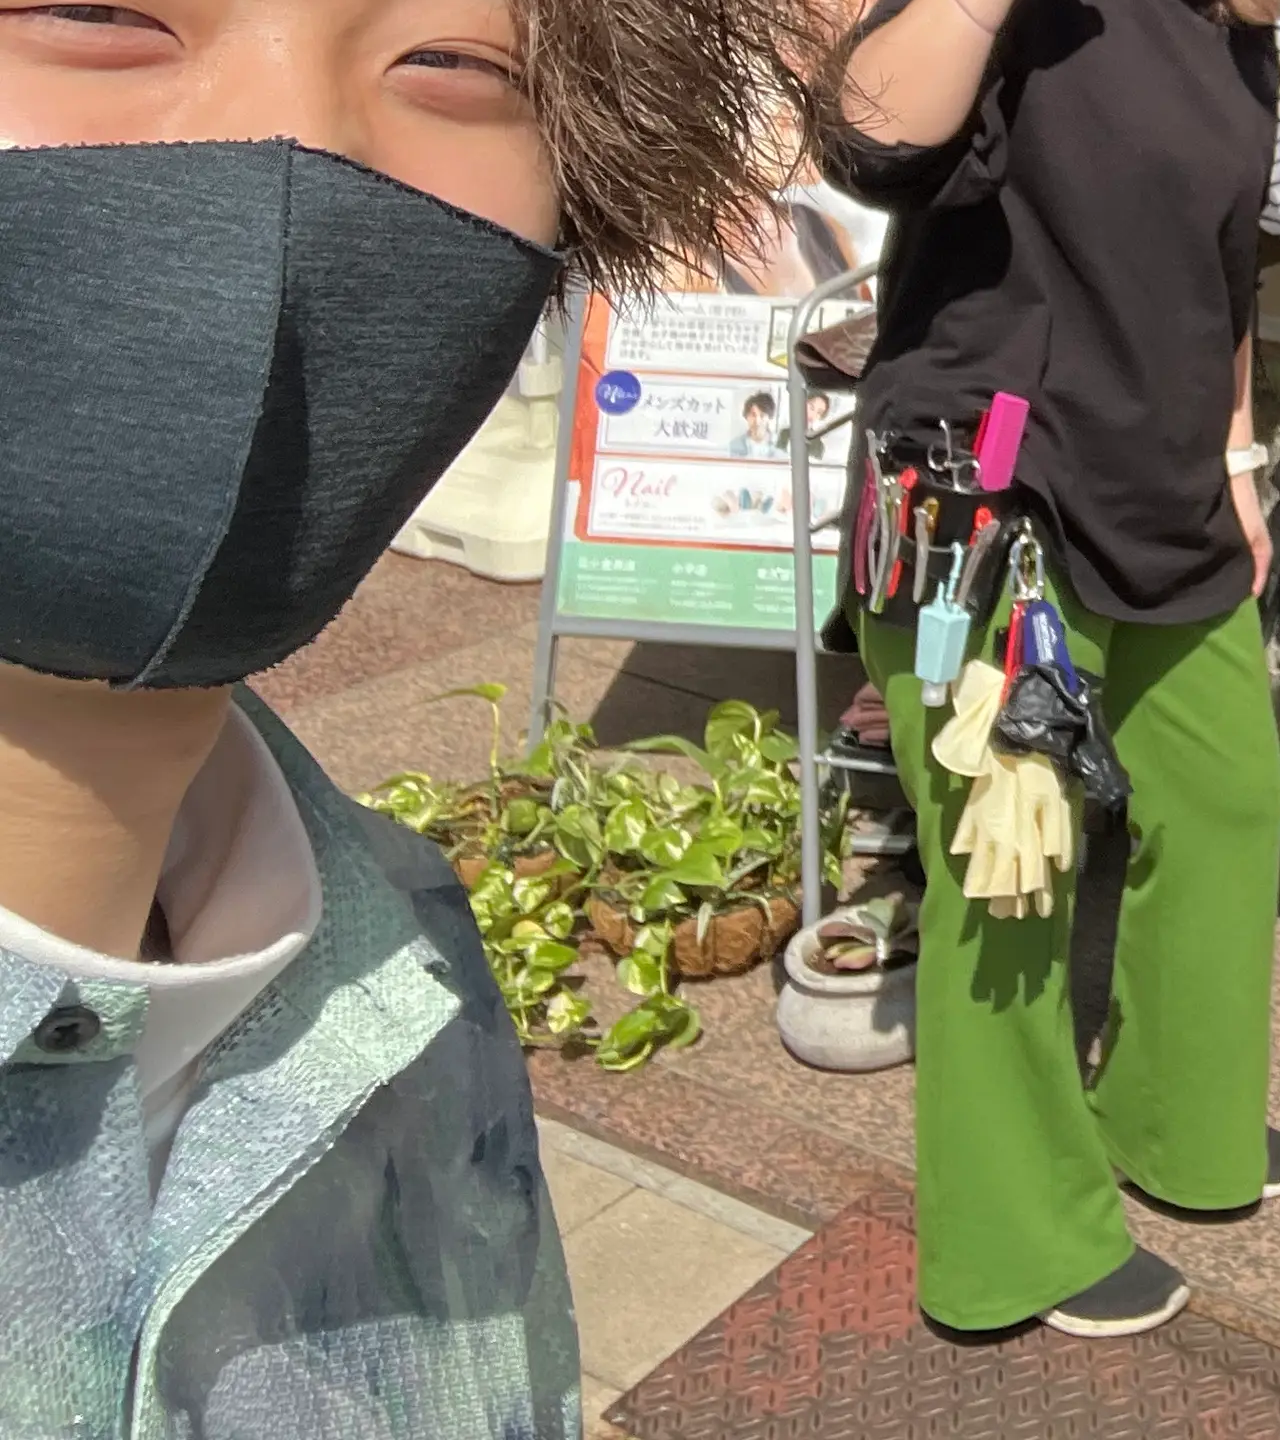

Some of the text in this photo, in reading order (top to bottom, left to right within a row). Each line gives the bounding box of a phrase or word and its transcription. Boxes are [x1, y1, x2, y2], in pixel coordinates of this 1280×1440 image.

[643, 391, 726, 414] メンズカット
[653, 417, 709, 440] 大歓迎
[600, 466, 678, 498] Nail
